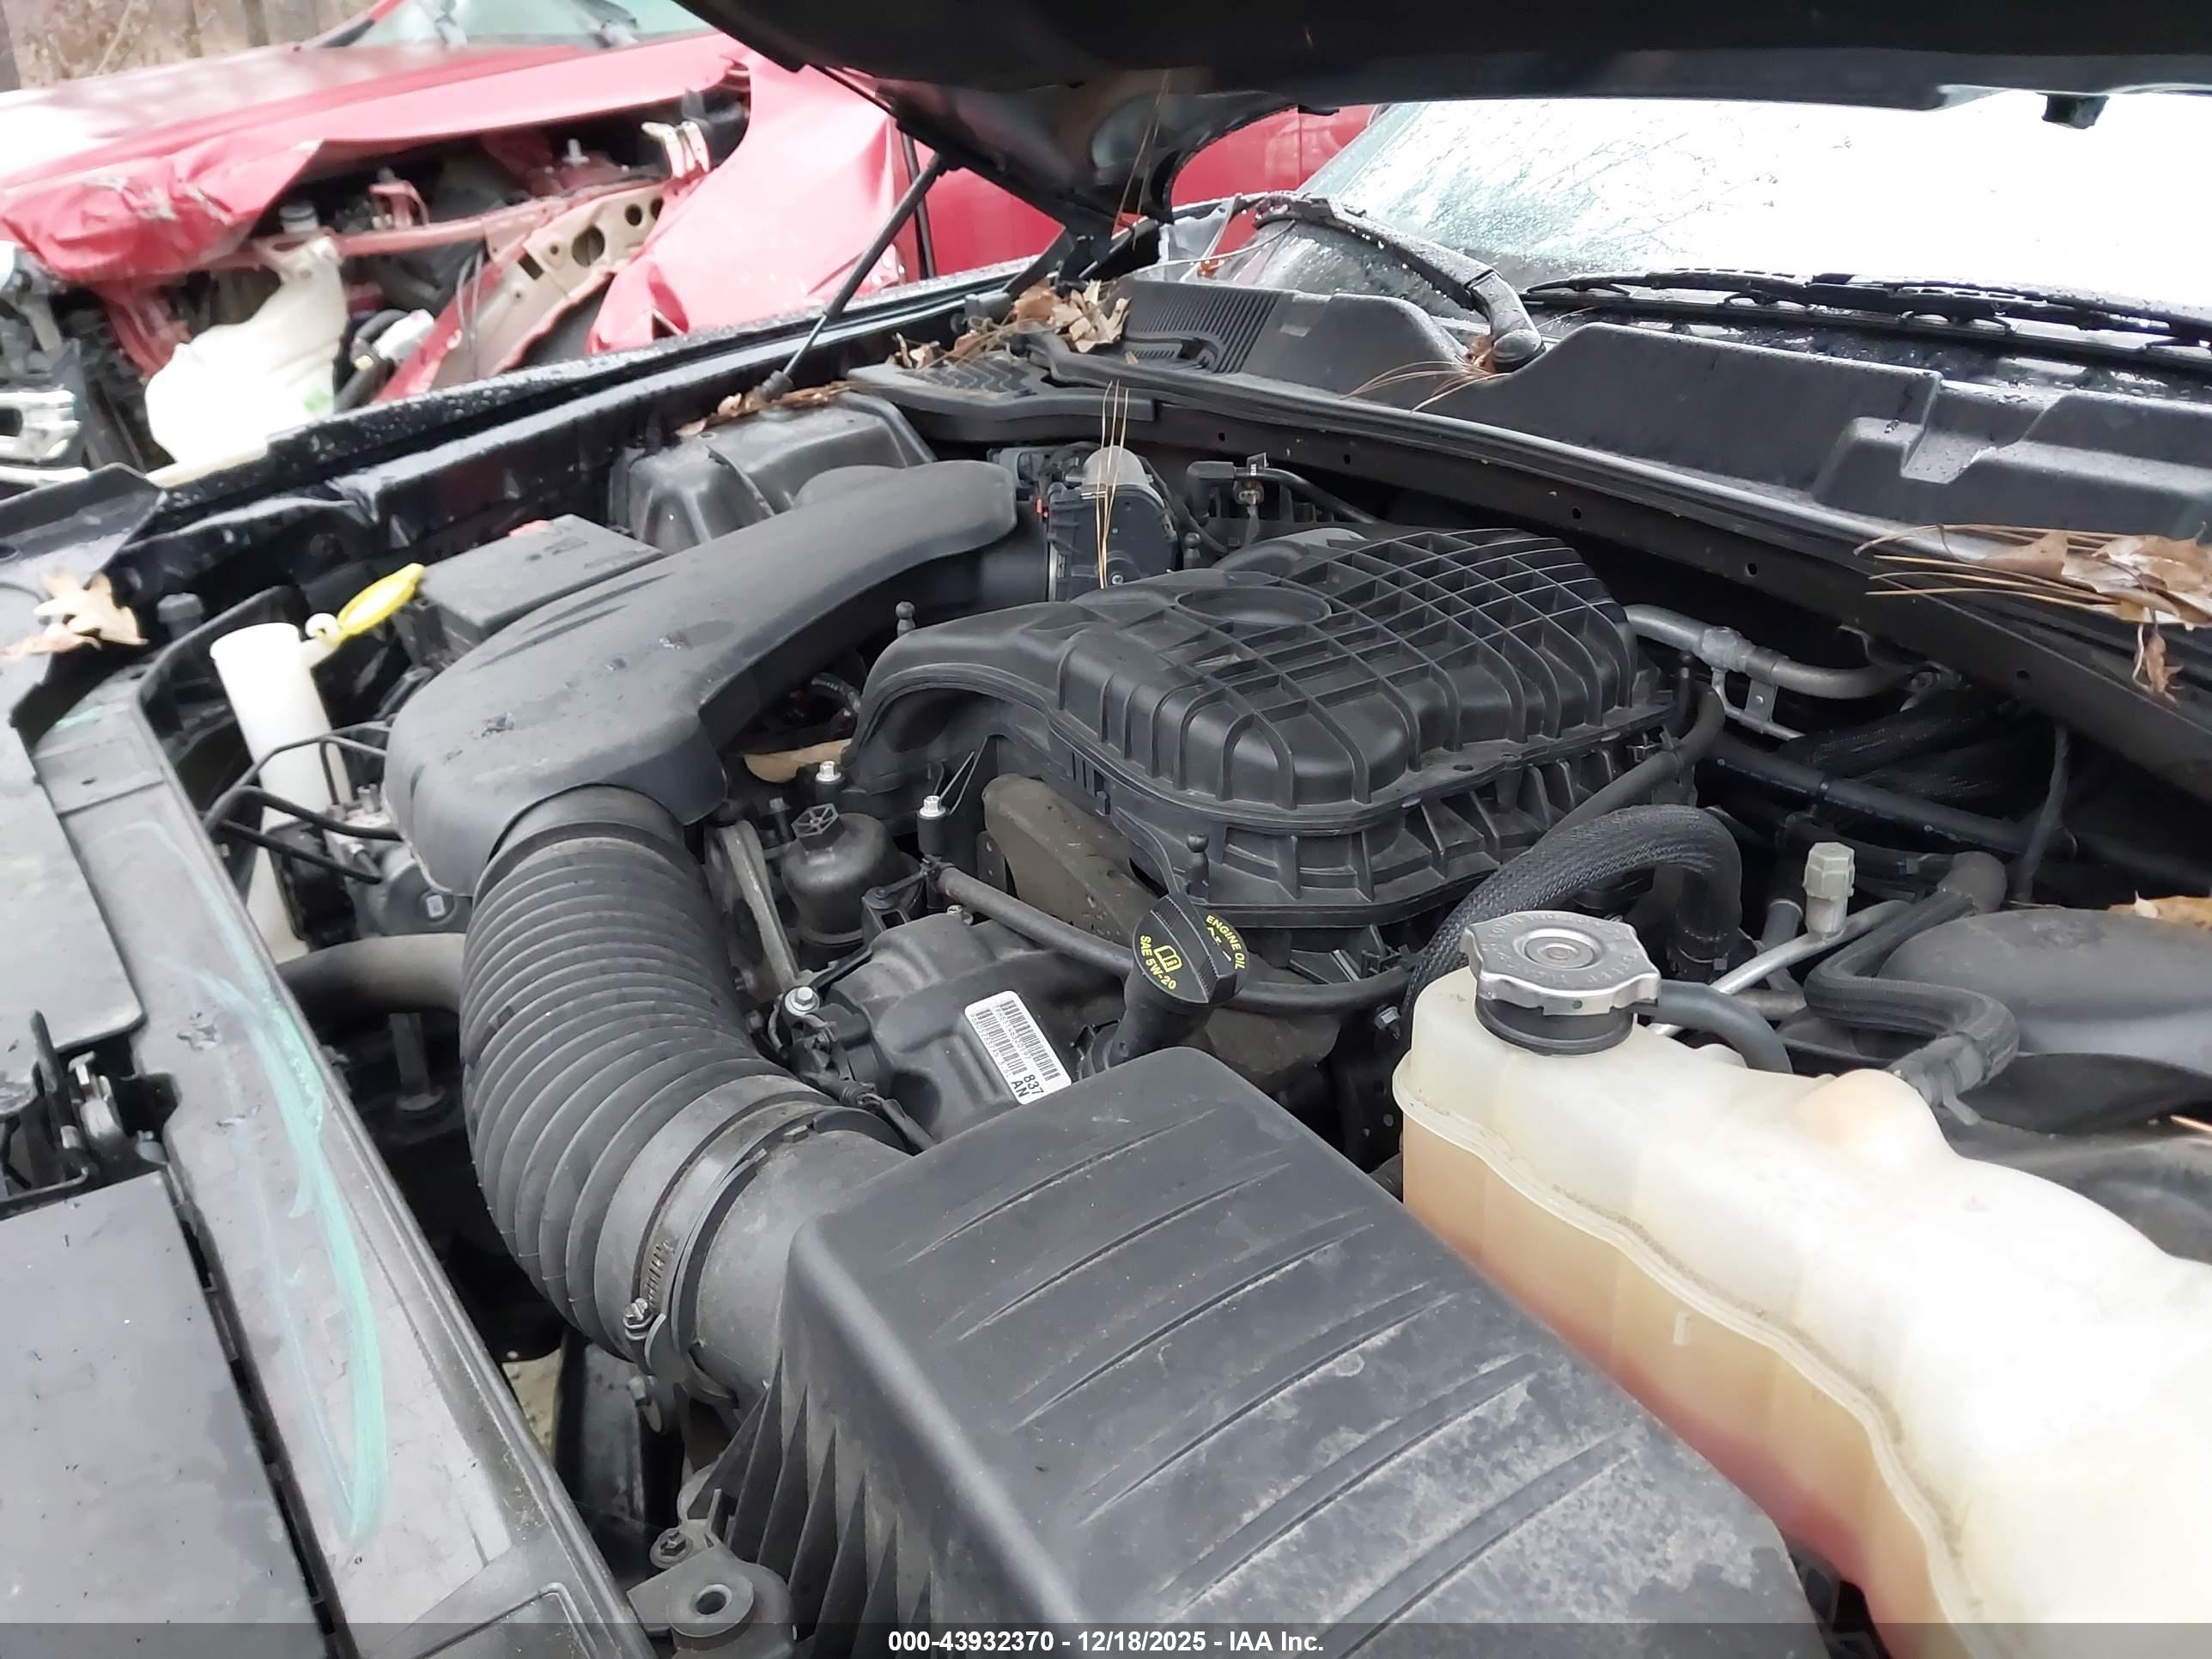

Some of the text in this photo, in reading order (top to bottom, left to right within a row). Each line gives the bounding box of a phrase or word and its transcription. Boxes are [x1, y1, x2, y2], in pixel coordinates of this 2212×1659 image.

[1205, 915, 1246, 969] ENGINE OIL
[1139, 934, 1177, 990] SAE 5W-20
[1011, 1079, 1030, 1098] AN
[1023, 1073, 1045, 1095] 837
